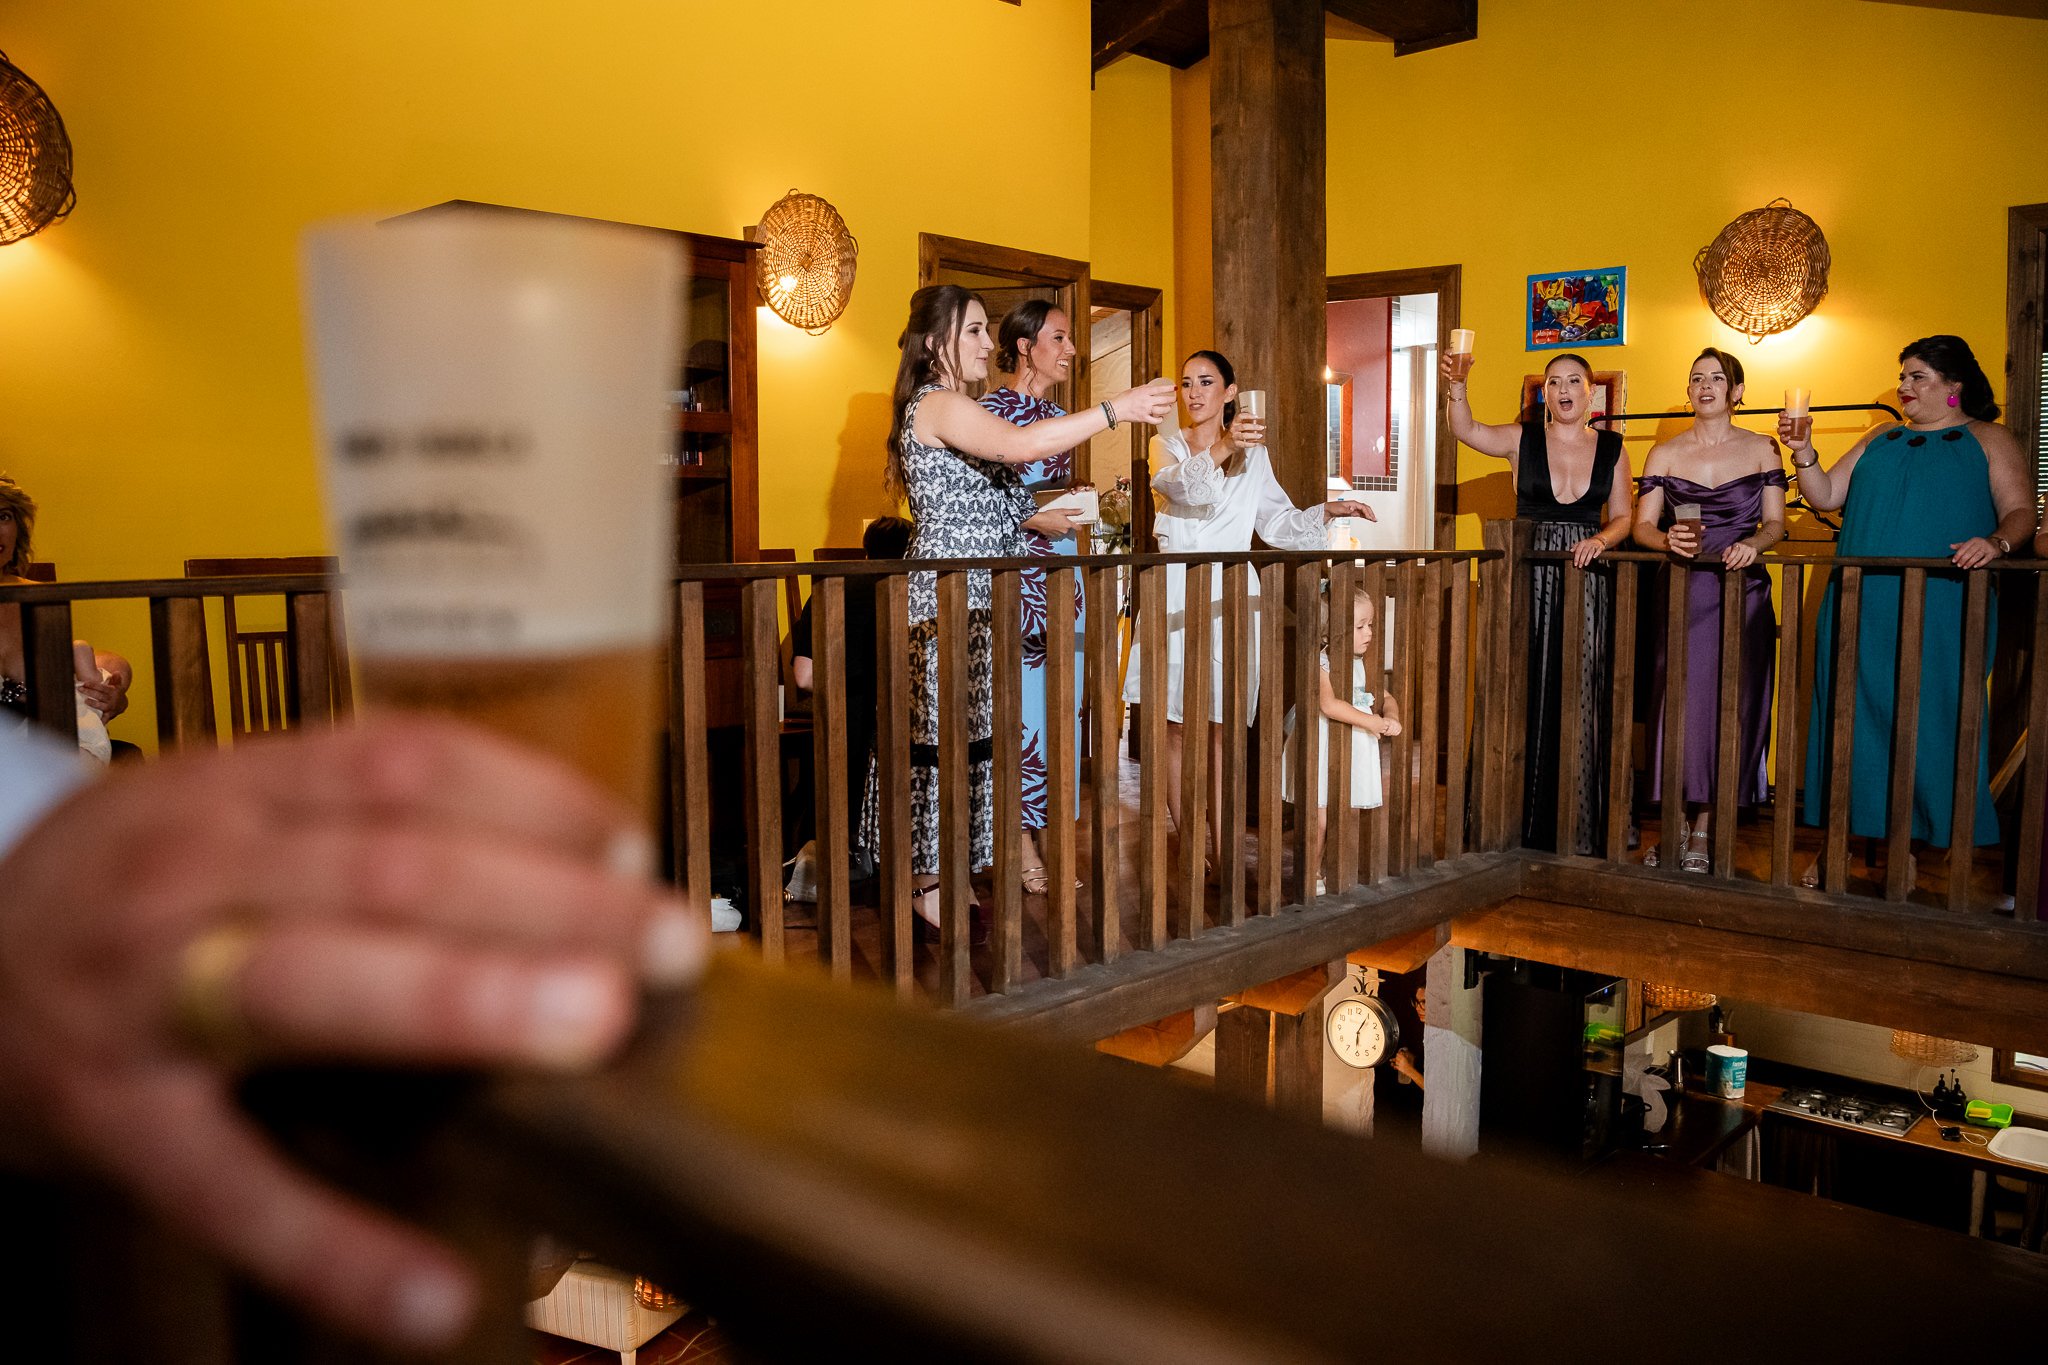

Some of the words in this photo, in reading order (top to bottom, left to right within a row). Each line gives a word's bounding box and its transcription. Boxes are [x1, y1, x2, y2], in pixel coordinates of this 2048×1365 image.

[1356, 1007, 1362, 1015] 12
[1339, 1013, 1345, 1021] 10
[1372, 1022, 1378, 1030] 2
[1345, 1045, 1350, 1053] 7
